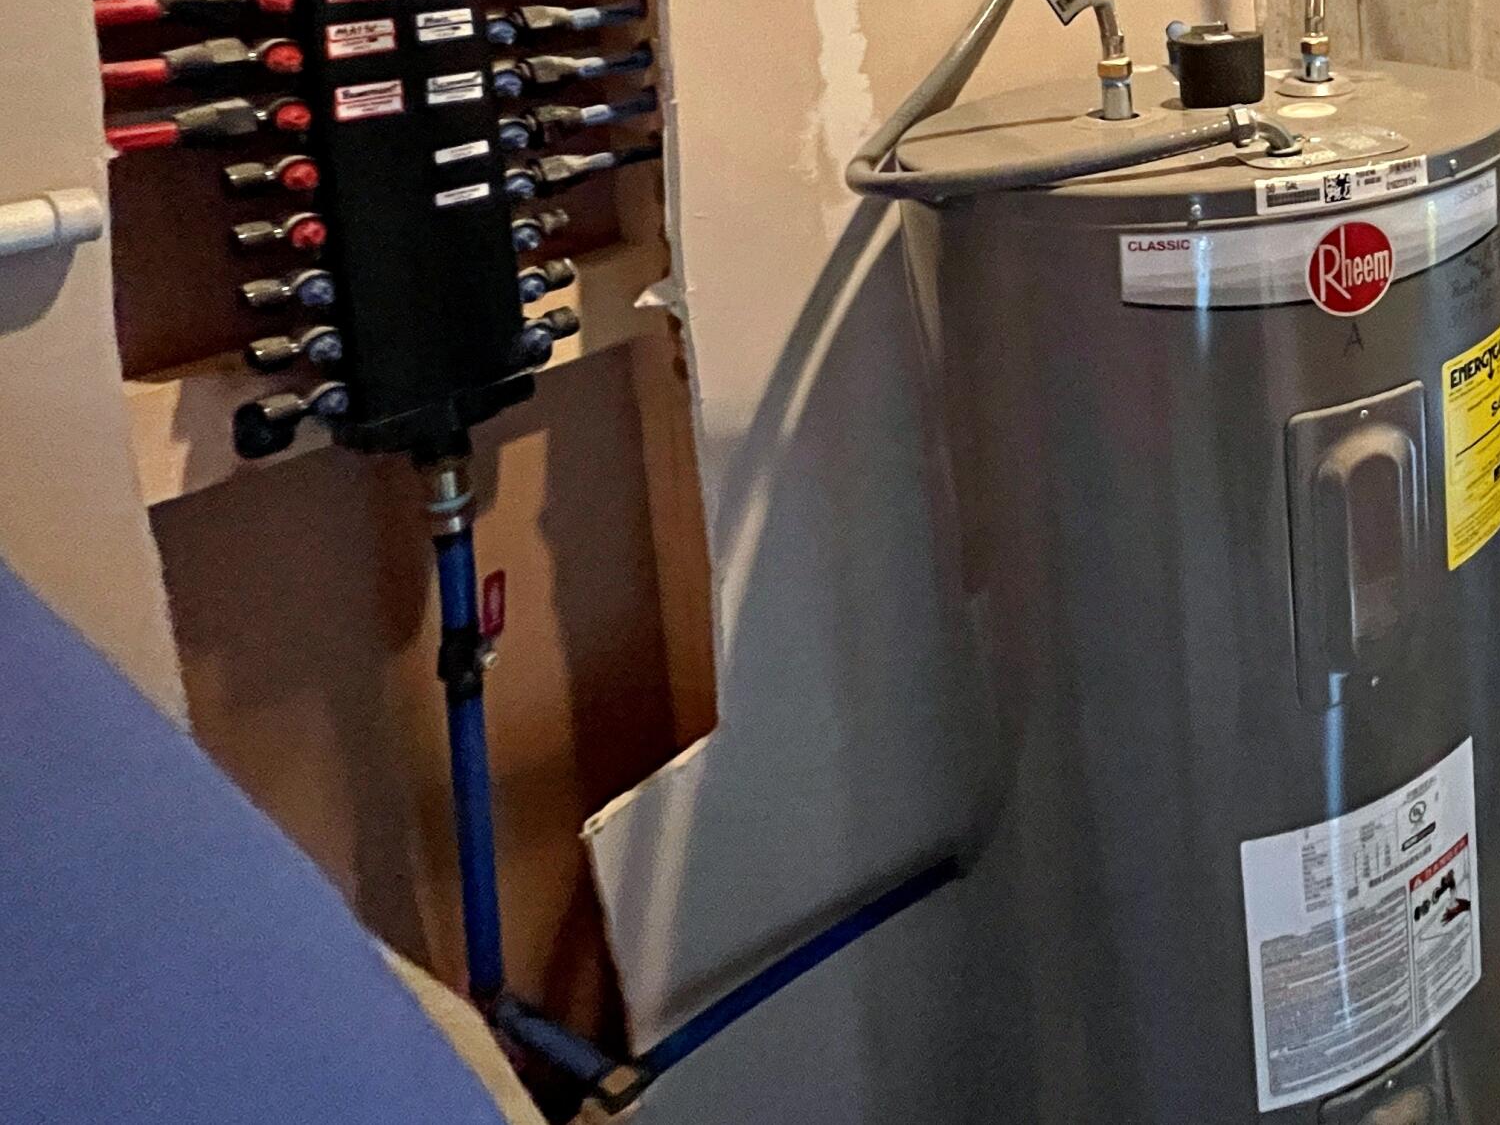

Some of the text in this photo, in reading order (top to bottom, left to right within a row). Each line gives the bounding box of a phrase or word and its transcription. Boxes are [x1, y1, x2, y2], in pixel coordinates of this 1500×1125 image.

[1127, 238, 1191, 253] CLASSIC
[1317, 224, 1391, 303] Rheem
[1344, 322, 1365, 354] A
